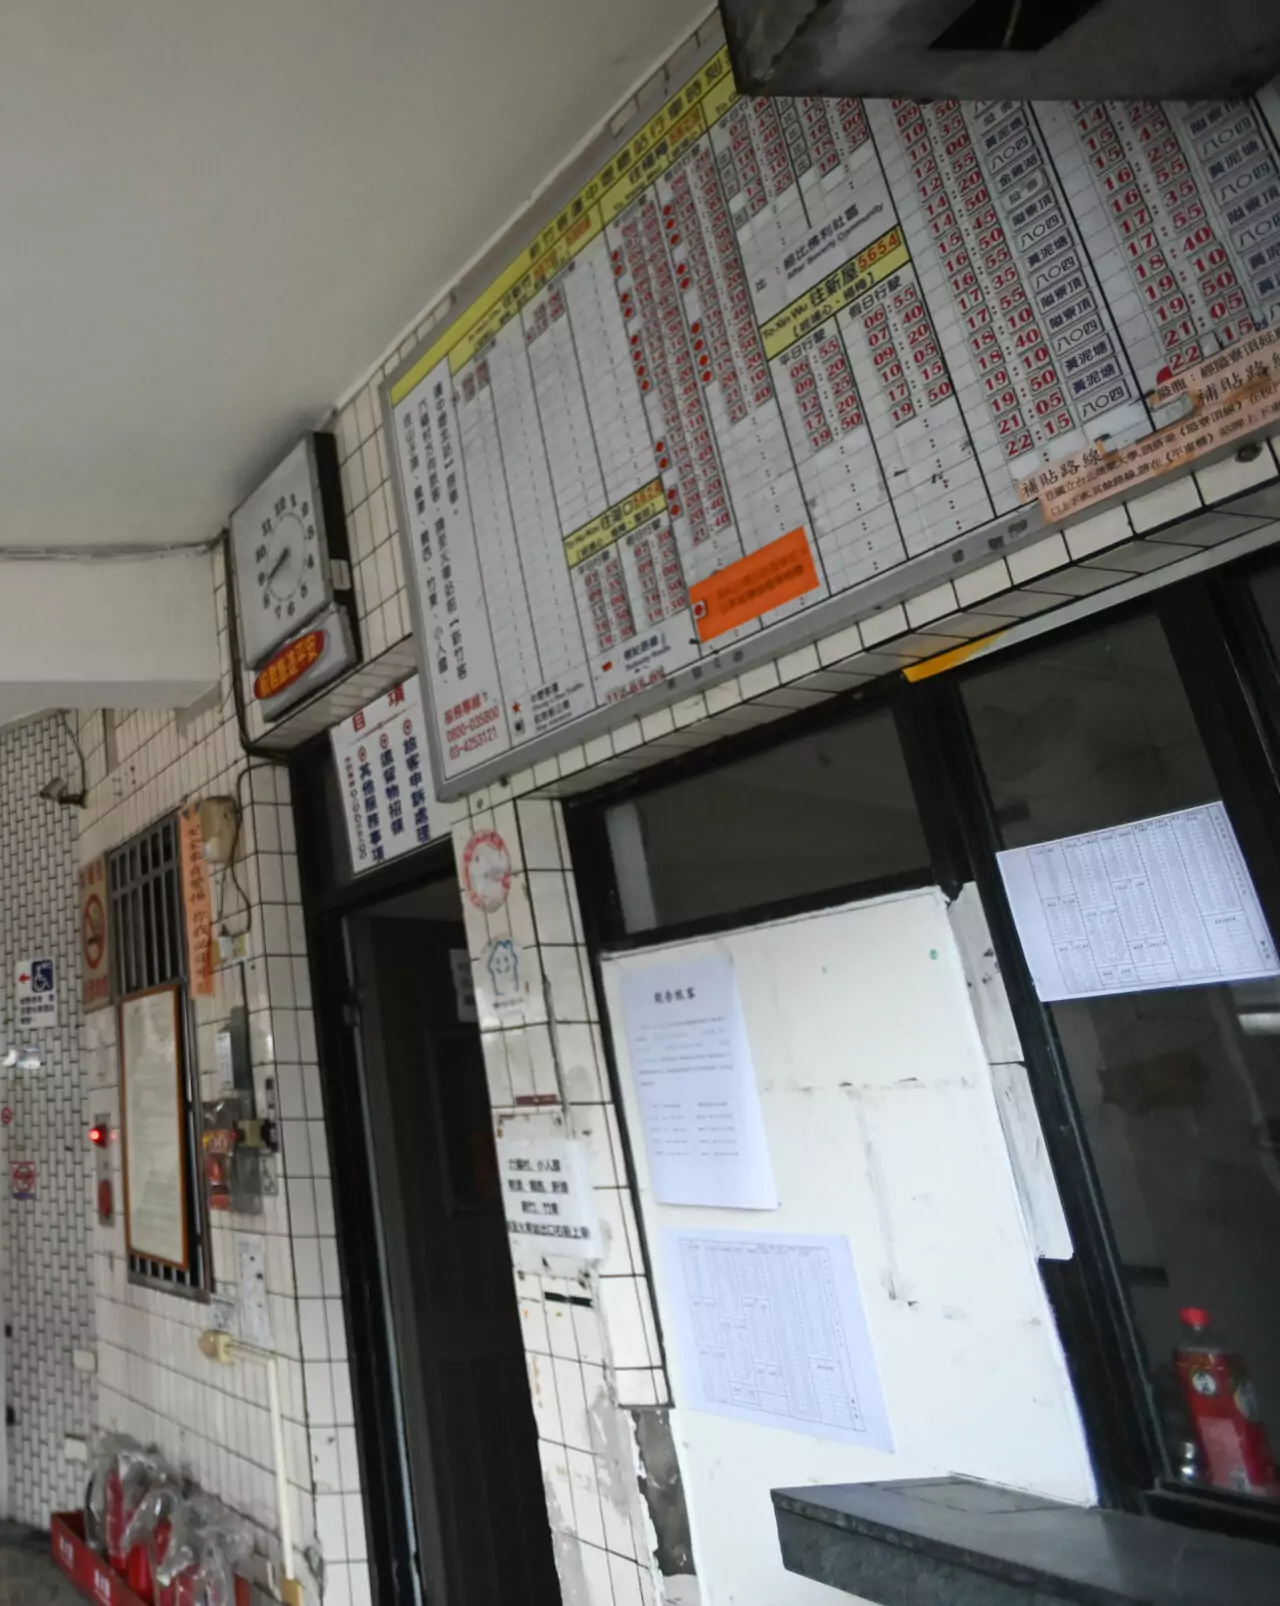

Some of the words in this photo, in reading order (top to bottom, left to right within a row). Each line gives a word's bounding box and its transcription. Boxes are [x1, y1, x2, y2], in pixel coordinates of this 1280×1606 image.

[809, 261, 859, 307] 往新屋
[858, 233, 899, 270] 5654
[1024, 448, 1103, 497] 補貼路線
[352, 709, 366, 732] 目
[358, 762, 386, 863] 其他服務事項
[380, 748, 405, 837] 遺留物招領
[402, 735, 432, 844] 旅客申訴處理
